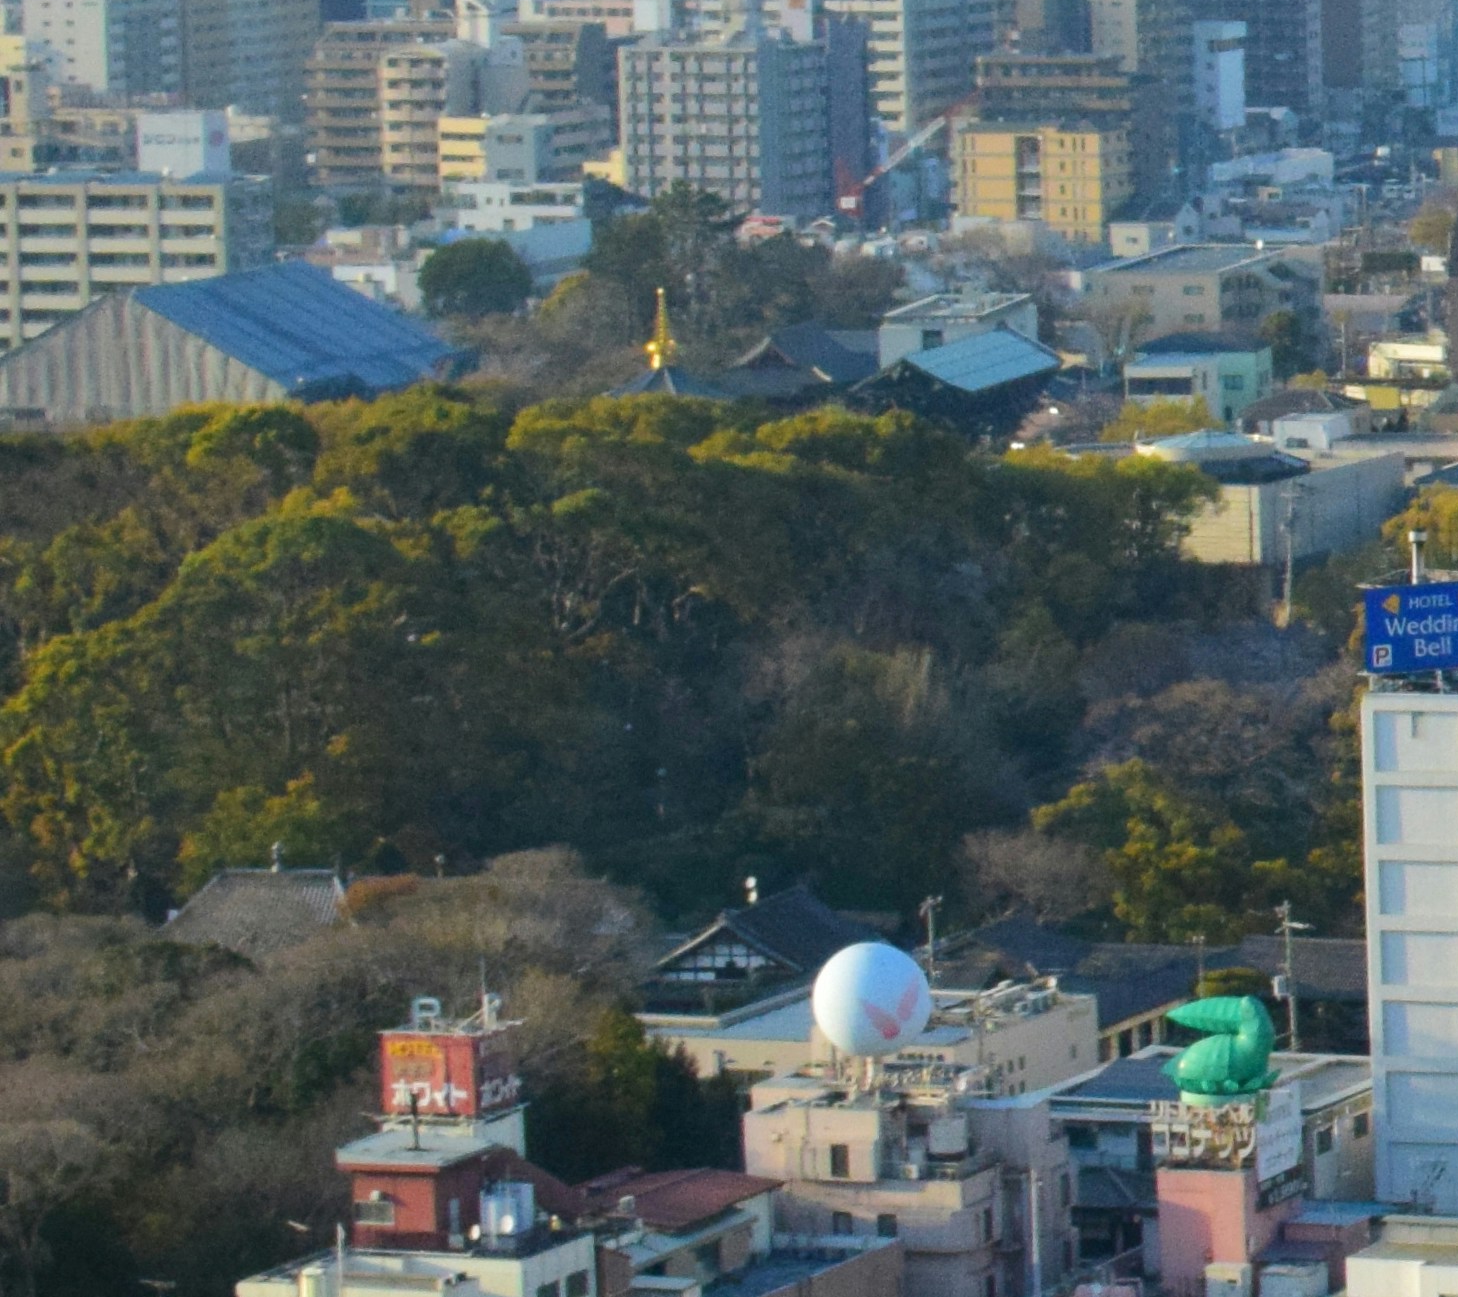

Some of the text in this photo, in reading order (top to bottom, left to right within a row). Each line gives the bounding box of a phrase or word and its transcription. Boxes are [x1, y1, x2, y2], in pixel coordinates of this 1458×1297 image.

[1408, 593, 1455, 610] HOTEL
[1376, 646, 1390, 664] P
[1414, 637, 1452, 658] Bell
